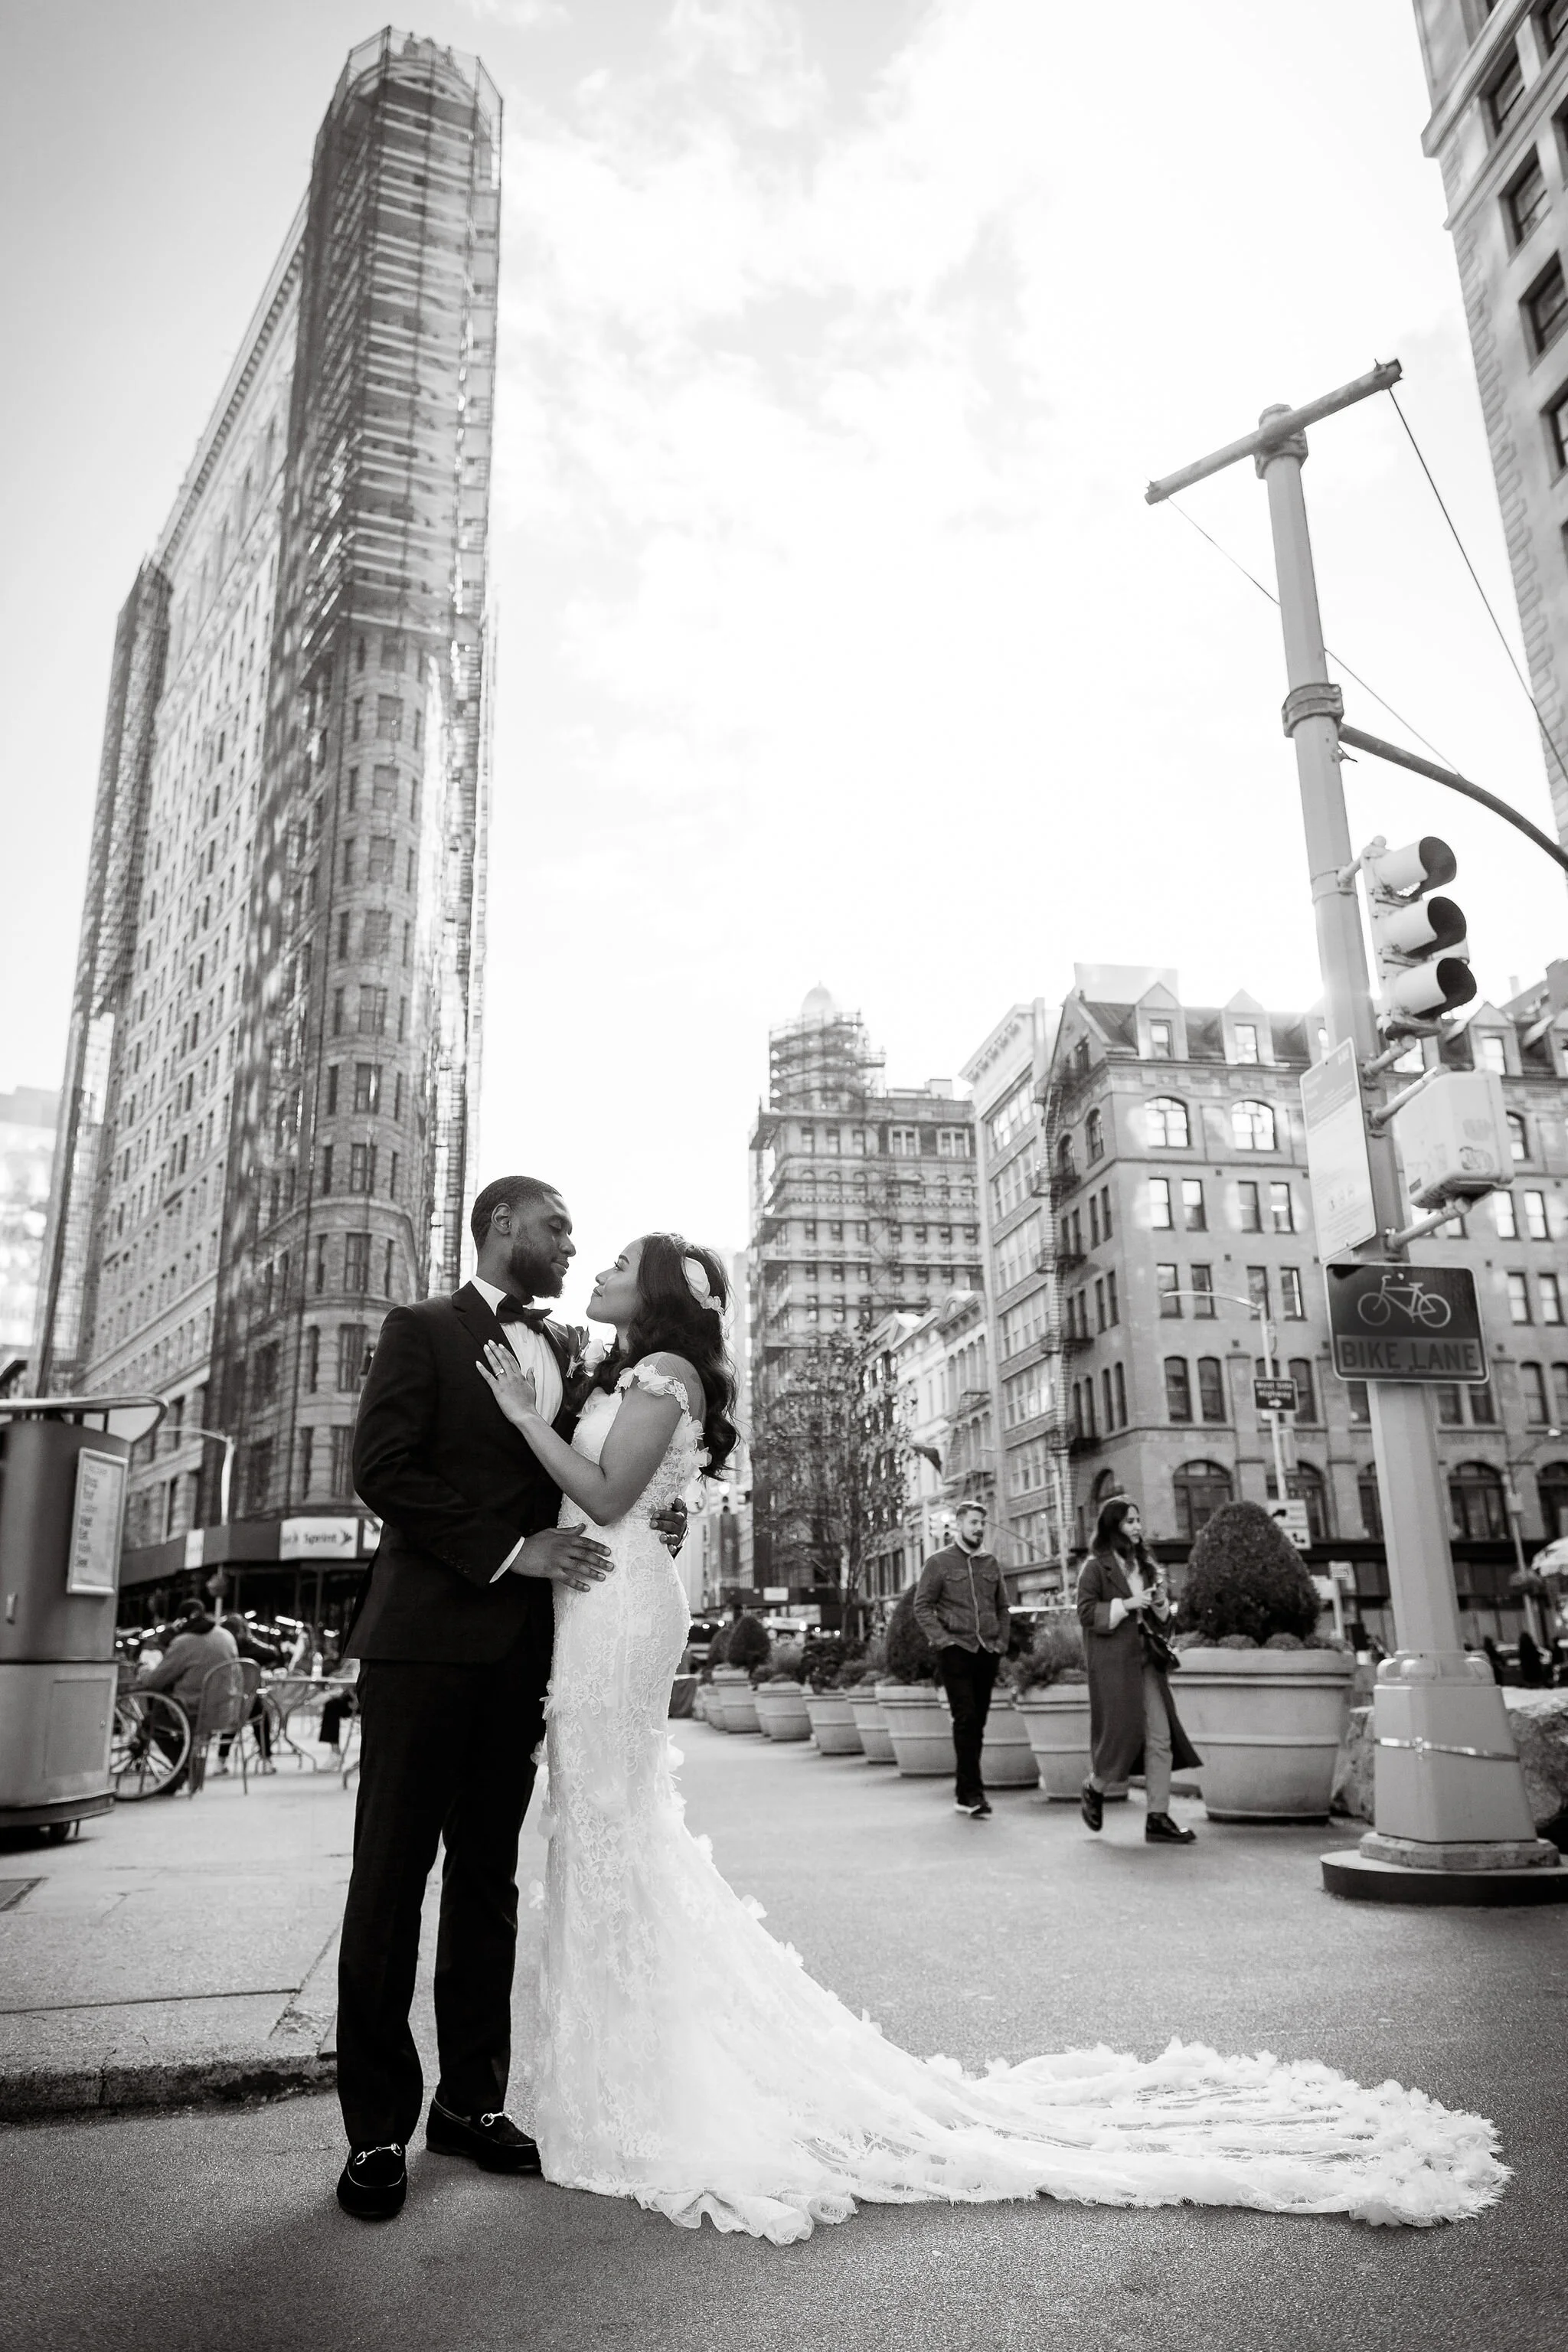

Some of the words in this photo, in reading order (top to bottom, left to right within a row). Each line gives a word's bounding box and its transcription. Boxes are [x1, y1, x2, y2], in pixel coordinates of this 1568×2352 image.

[1341, 1341, 1402, 1370] BIKE
[1410, 1343, 1478, 1371] LANE
[1258, 1390, 1292, 1400] Highway
[304, 1532, 337, 1545] Sprint
